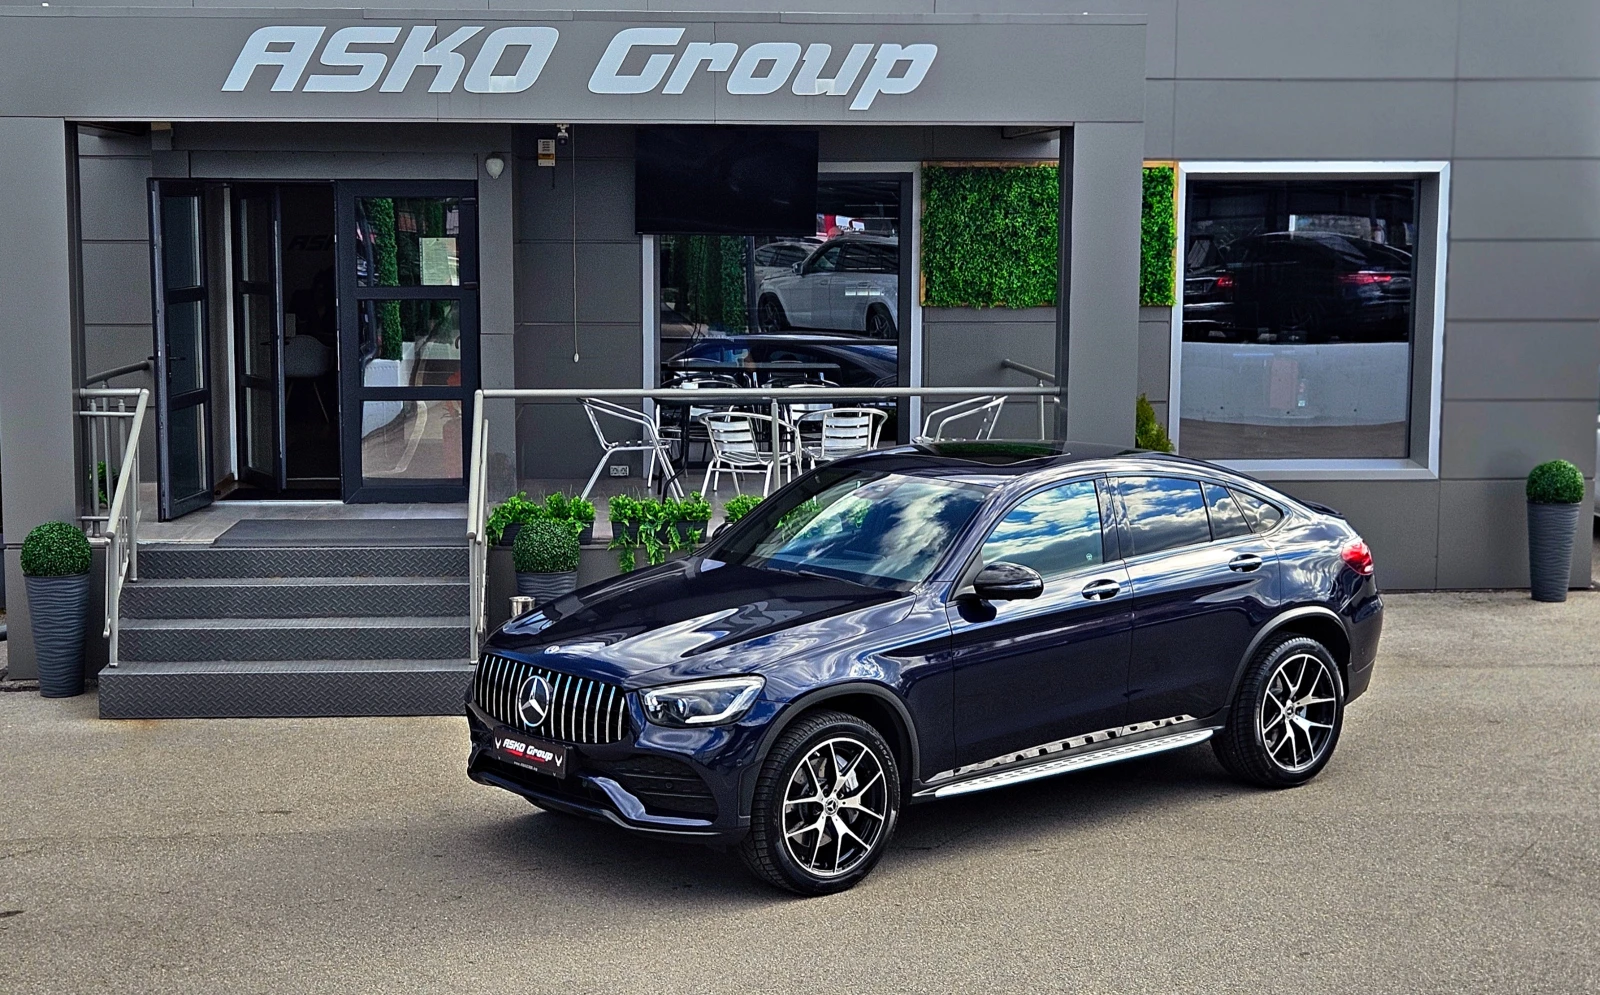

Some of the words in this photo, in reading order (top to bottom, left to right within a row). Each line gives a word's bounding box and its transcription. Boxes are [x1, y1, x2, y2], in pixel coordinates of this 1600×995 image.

[220, 25, 560, 94] ASKO
[587, 27, 938, 110] Group
[502, 738, 526, 753] ASKO
[526, 745, 554, 762] Group
